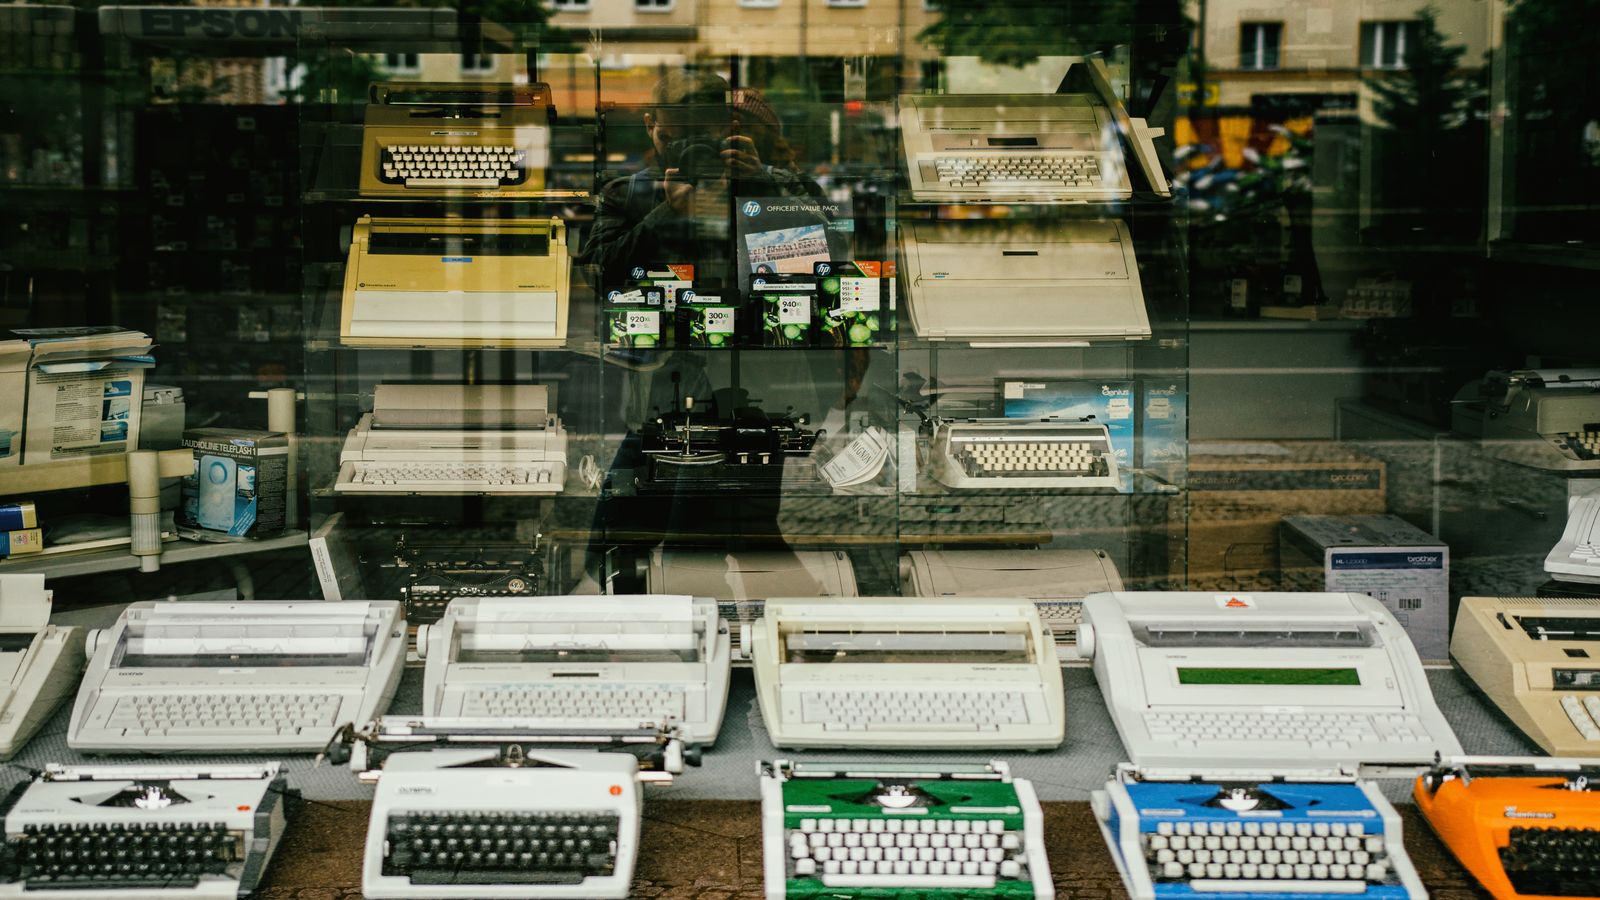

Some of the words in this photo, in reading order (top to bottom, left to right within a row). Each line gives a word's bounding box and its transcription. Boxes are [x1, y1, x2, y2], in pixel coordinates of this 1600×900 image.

[141, 9, 301, 37] EPSON
[744, 201, 761, 217] hp
[632, 267, 645, 279] hp
[817, 264, 831, 276] hp
[683, 291, 696, 303] hp
[1102, 387, 1129, 396] Genius
[220, 443, 252, 455] TELEFLASH
[852, 441, 872, 465] MIGNON
[1331, 474, 1370, 483] brother
